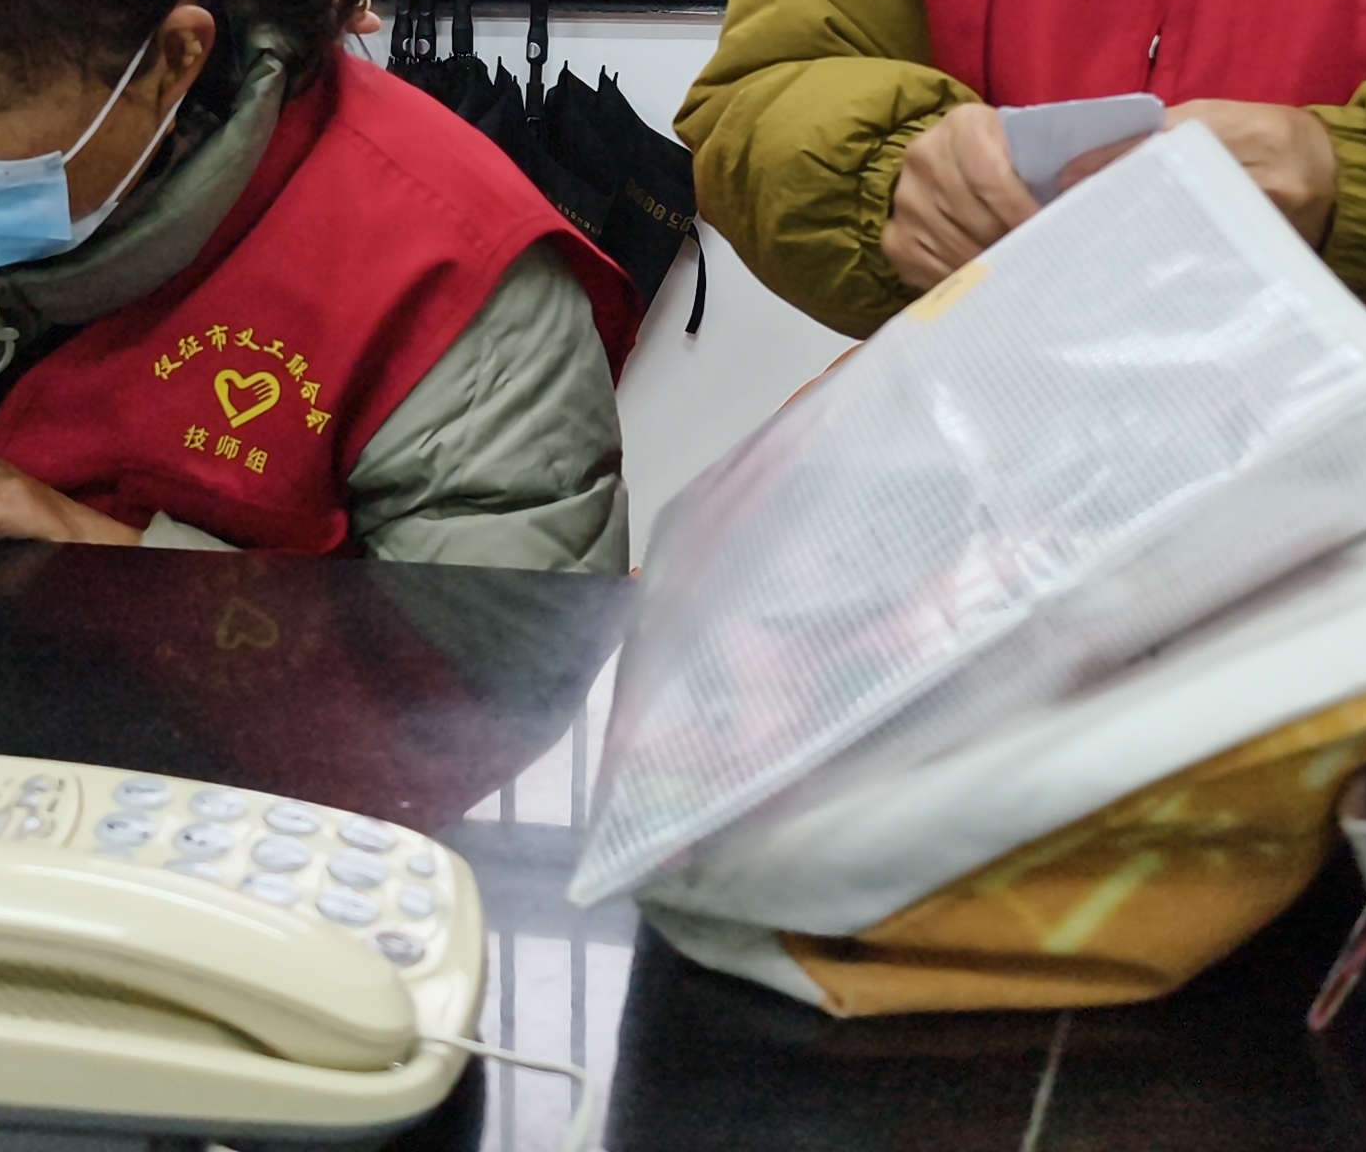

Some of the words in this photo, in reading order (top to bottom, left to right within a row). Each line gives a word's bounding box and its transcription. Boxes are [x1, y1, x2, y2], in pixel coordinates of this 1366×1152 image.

[153, 324, 333, 434] 仪征市义工联合会
[183, 424, 269, 474] 技师组
